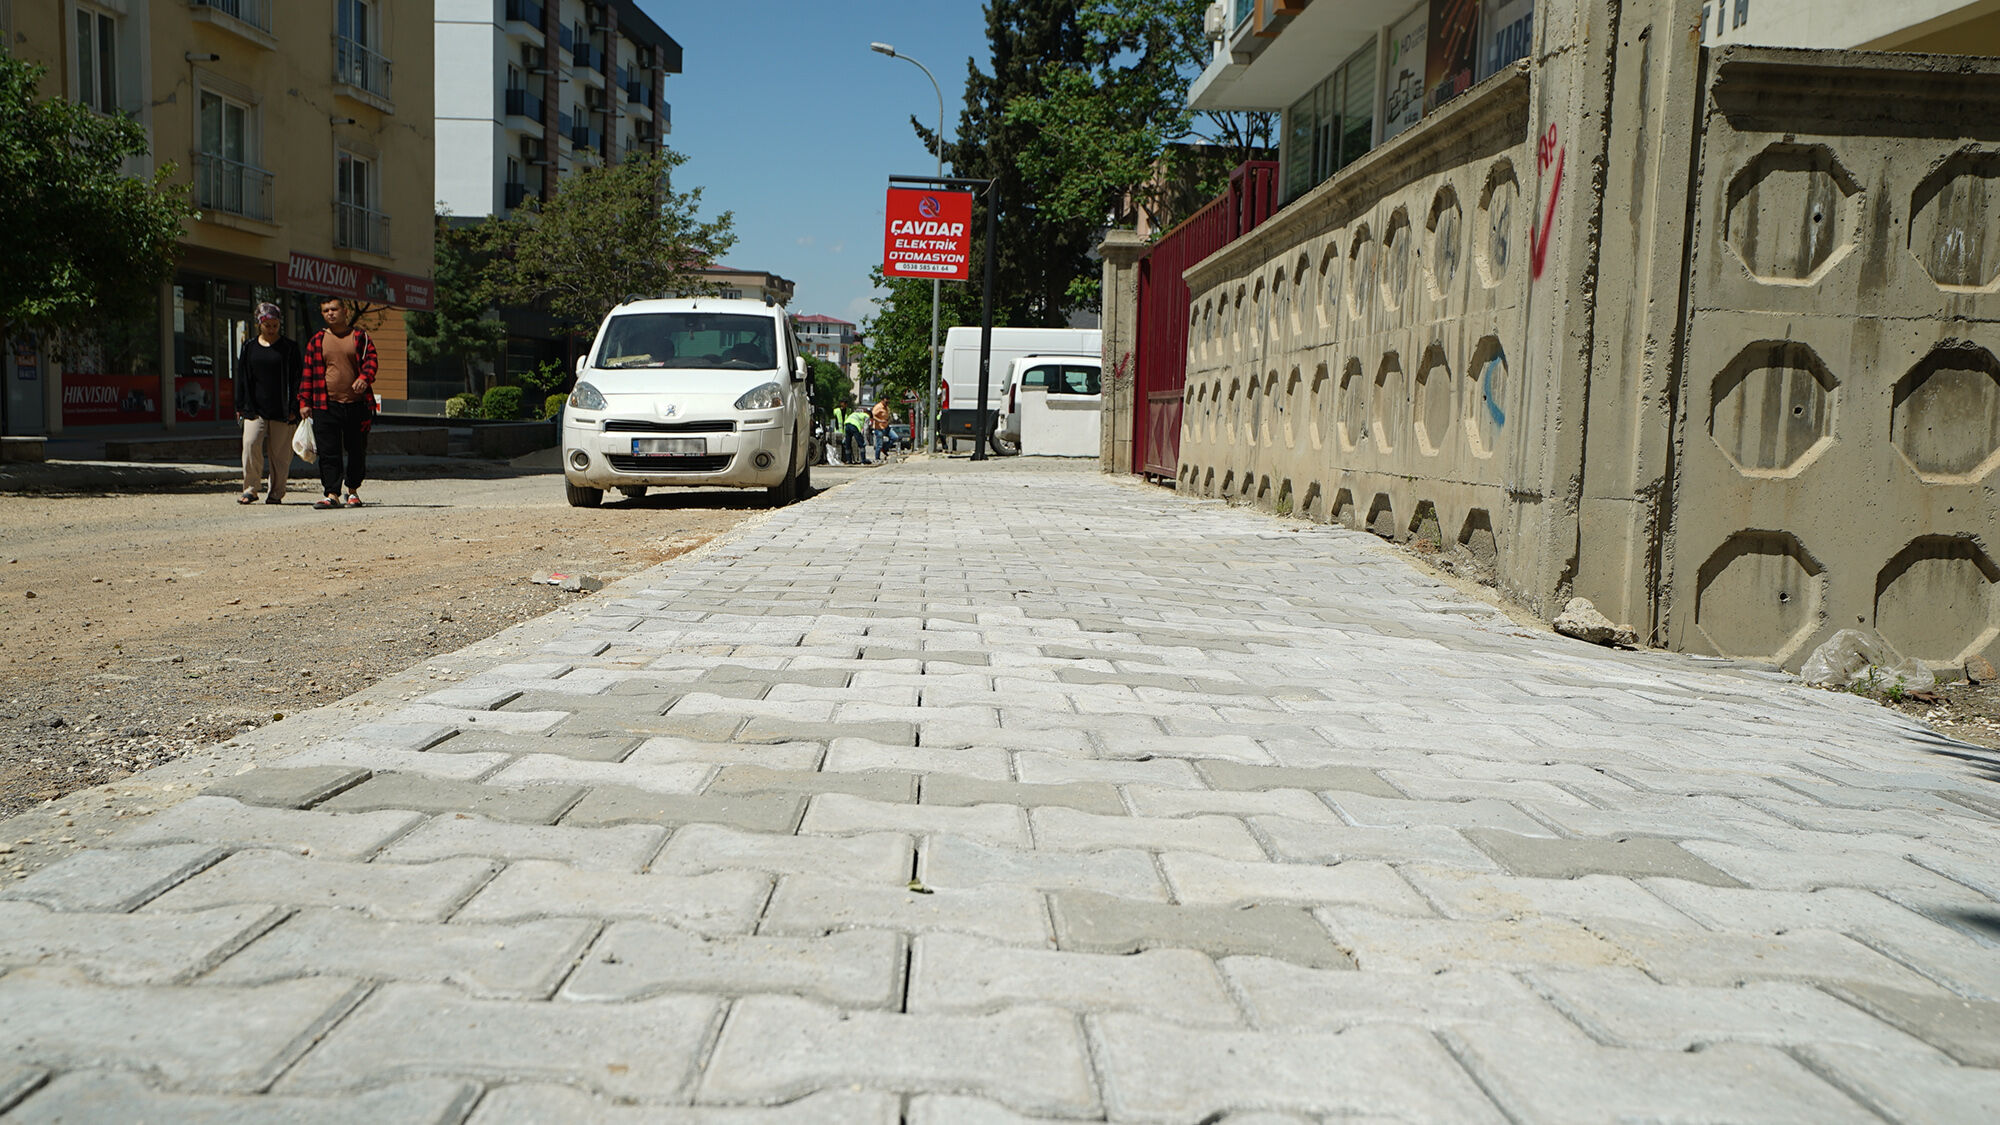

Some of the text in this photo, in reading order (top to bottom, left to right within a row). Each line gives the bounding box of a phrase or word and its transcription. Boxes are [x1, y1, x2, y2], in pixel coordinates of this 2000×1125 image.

[890, 220, 964, 237] ÇAVDAR
[895, 239, 957, 251] ELEKTRİK
[889, 251, 964, 263] OTOMASYON
[288, 255, 359, 289] HIKVISION
[64, 386, 119, 403] HIKVISION
